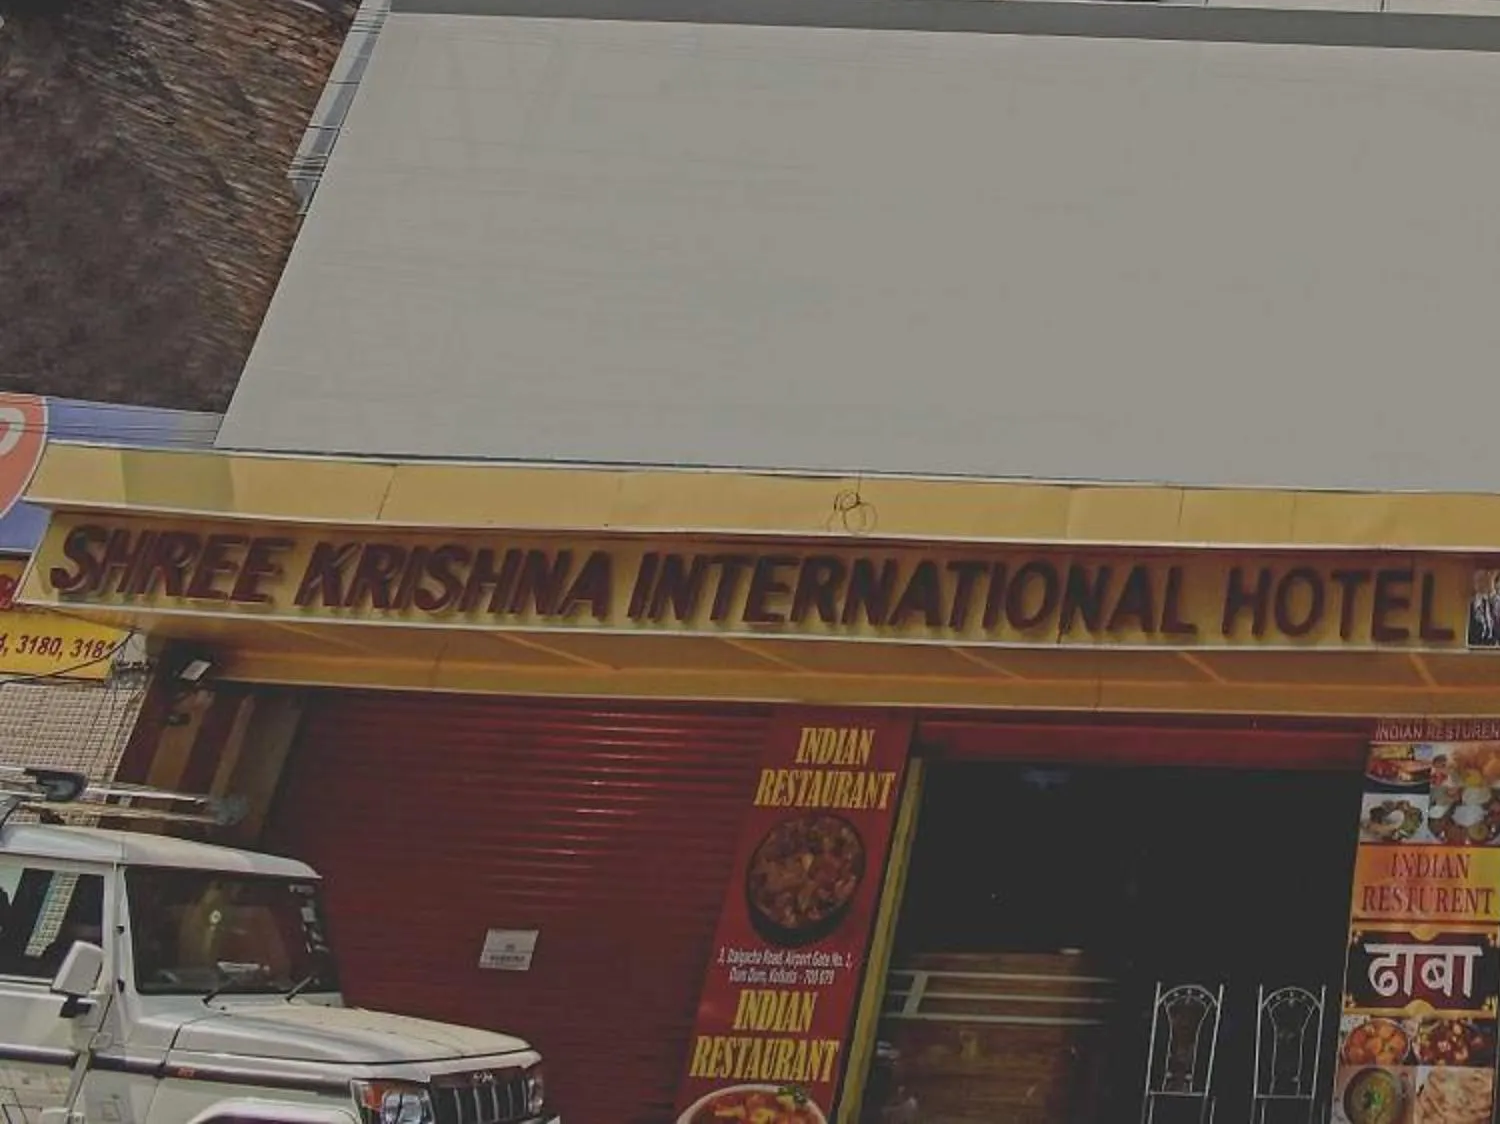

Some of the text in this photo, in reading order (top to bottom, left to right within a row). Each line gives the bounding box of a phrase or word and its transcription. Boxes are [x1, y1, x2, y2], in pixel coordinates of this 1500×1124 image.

[51, 525, 294, 603] SHREE
[294, 540, 612, 618] KRISHNA
[627, 552, 1198, 636] INTERNATIONAL
[1221, 566, 1456, 642] HOTEL
[795, 726, 876, 766] INDIAN
[1375, 722, 1424, 742] INDIAN
[753, 769, 897, 810] RESTAURANT
[1390, 852, 1471, 880] INDIAN
[1361, 886, 1496, 915] RESTURENT
[1363, 943, 1483, 998] ढाबा
[732, 989, 819, 1033] INDIAN
[689, 1036, 840, 1083] RESTAURANT
